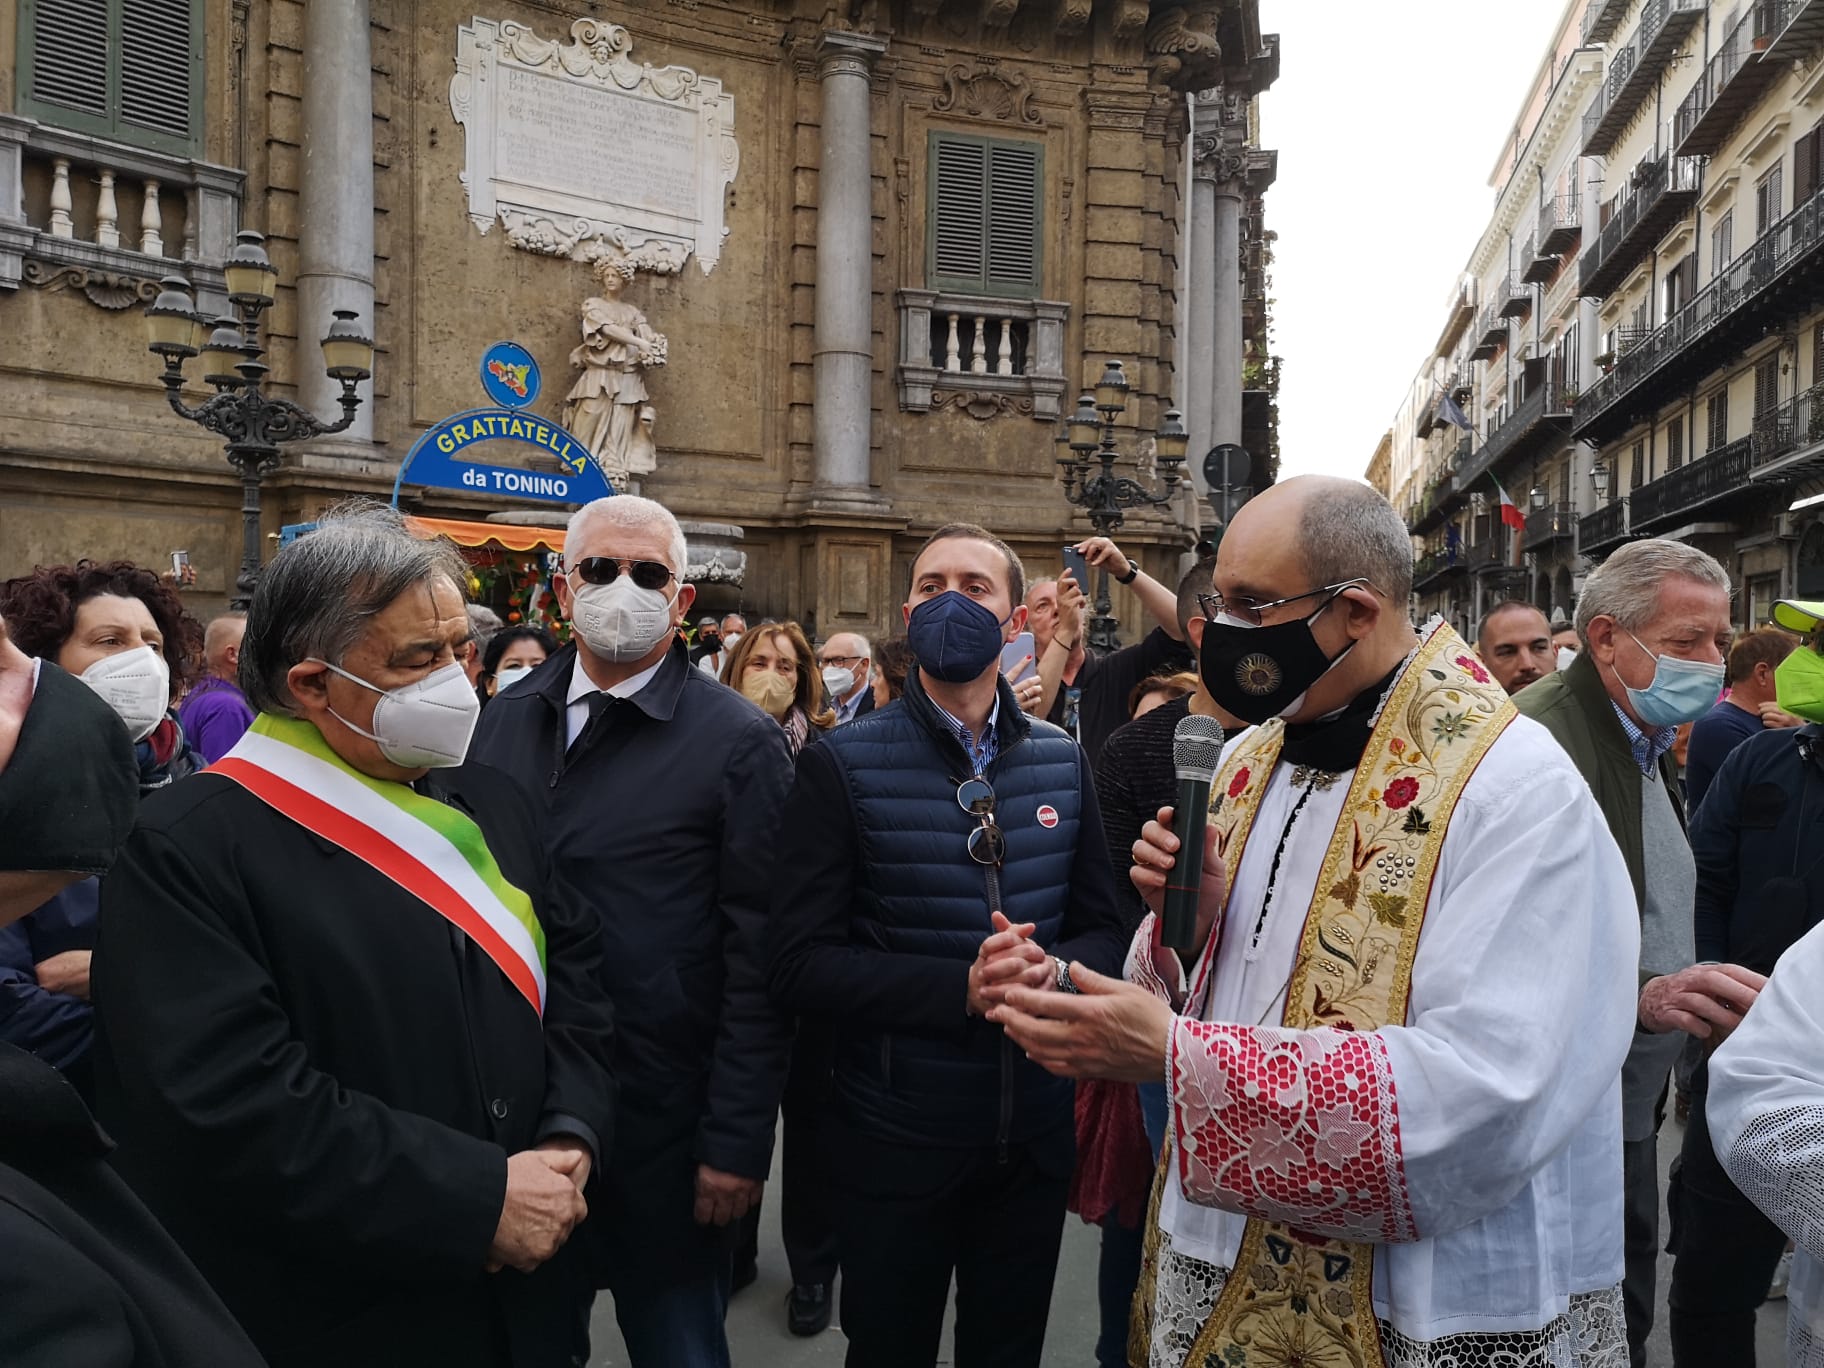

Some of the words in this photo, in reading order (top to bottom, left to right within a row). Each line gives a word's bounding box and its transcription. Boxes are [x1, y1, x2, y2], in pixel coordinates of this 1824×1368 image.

[437, 416, 588, 475] GRATTATELLA
[462, 468, 487, 487] da
[491, 471, 568, 497] TONINO
